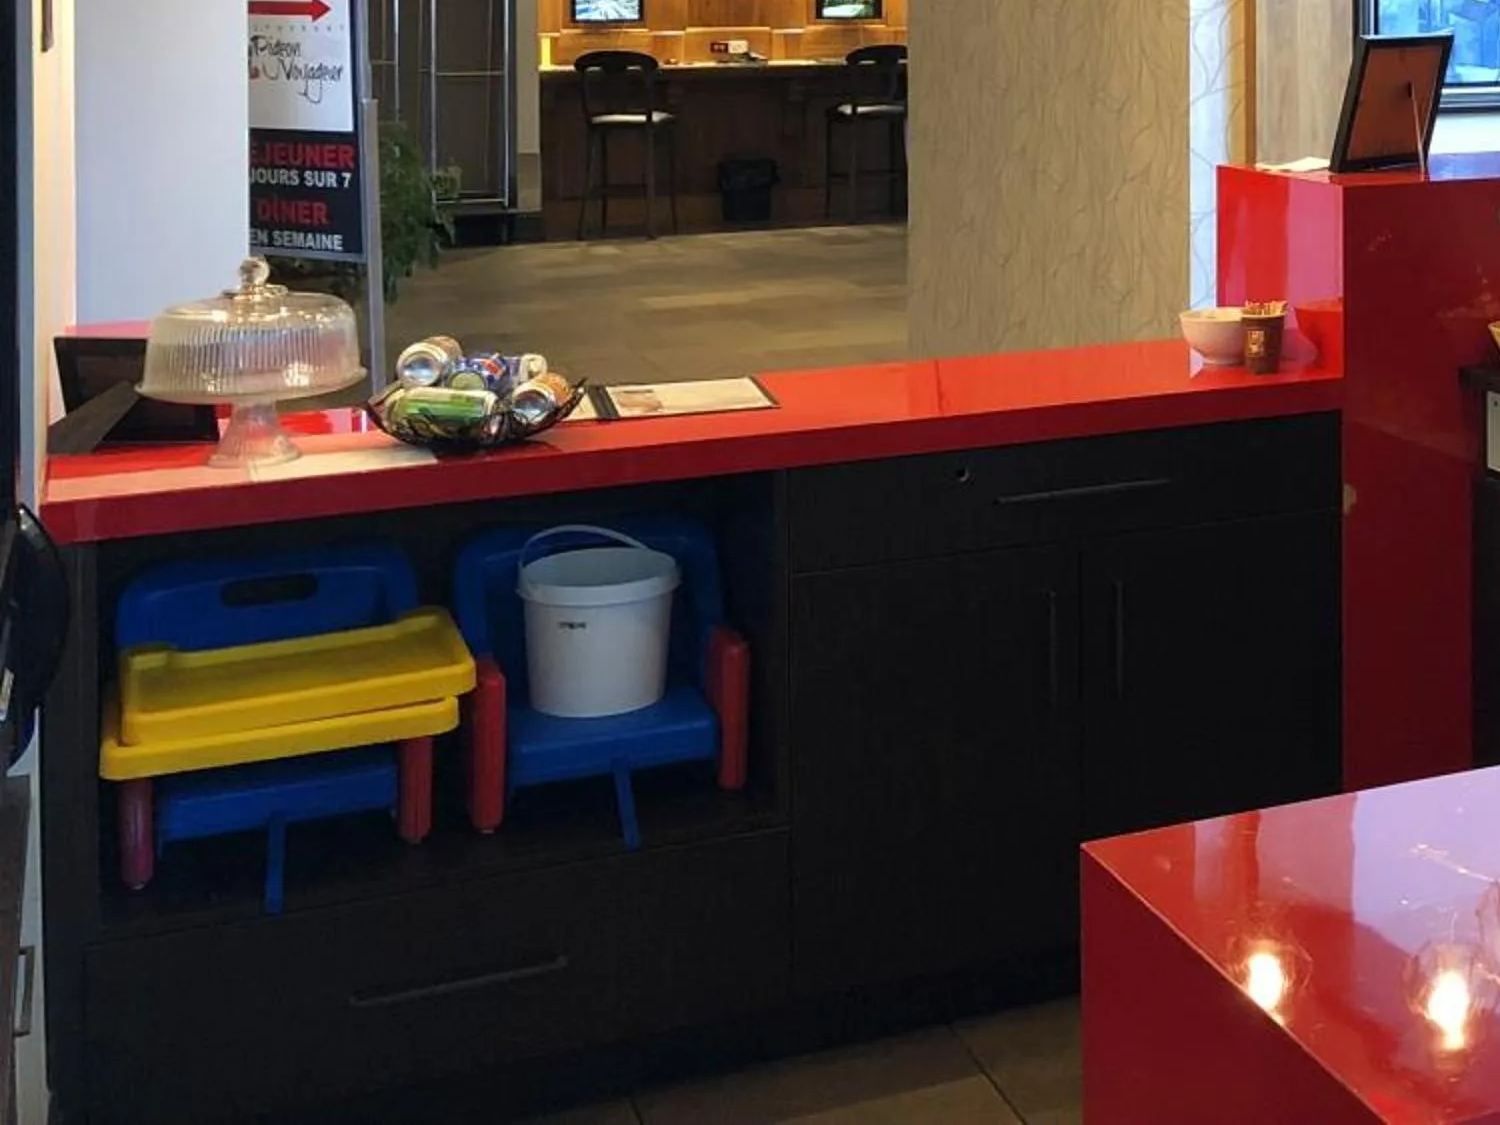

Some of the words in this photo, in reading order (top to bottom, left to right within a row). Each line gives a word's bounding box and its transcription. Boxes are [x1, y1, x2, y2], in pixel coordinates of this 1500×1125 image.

[303, 170, 338, 188] SUR
[340, 172, 352, 188] 7
[271, 230, 344, 250] SEMAINE
